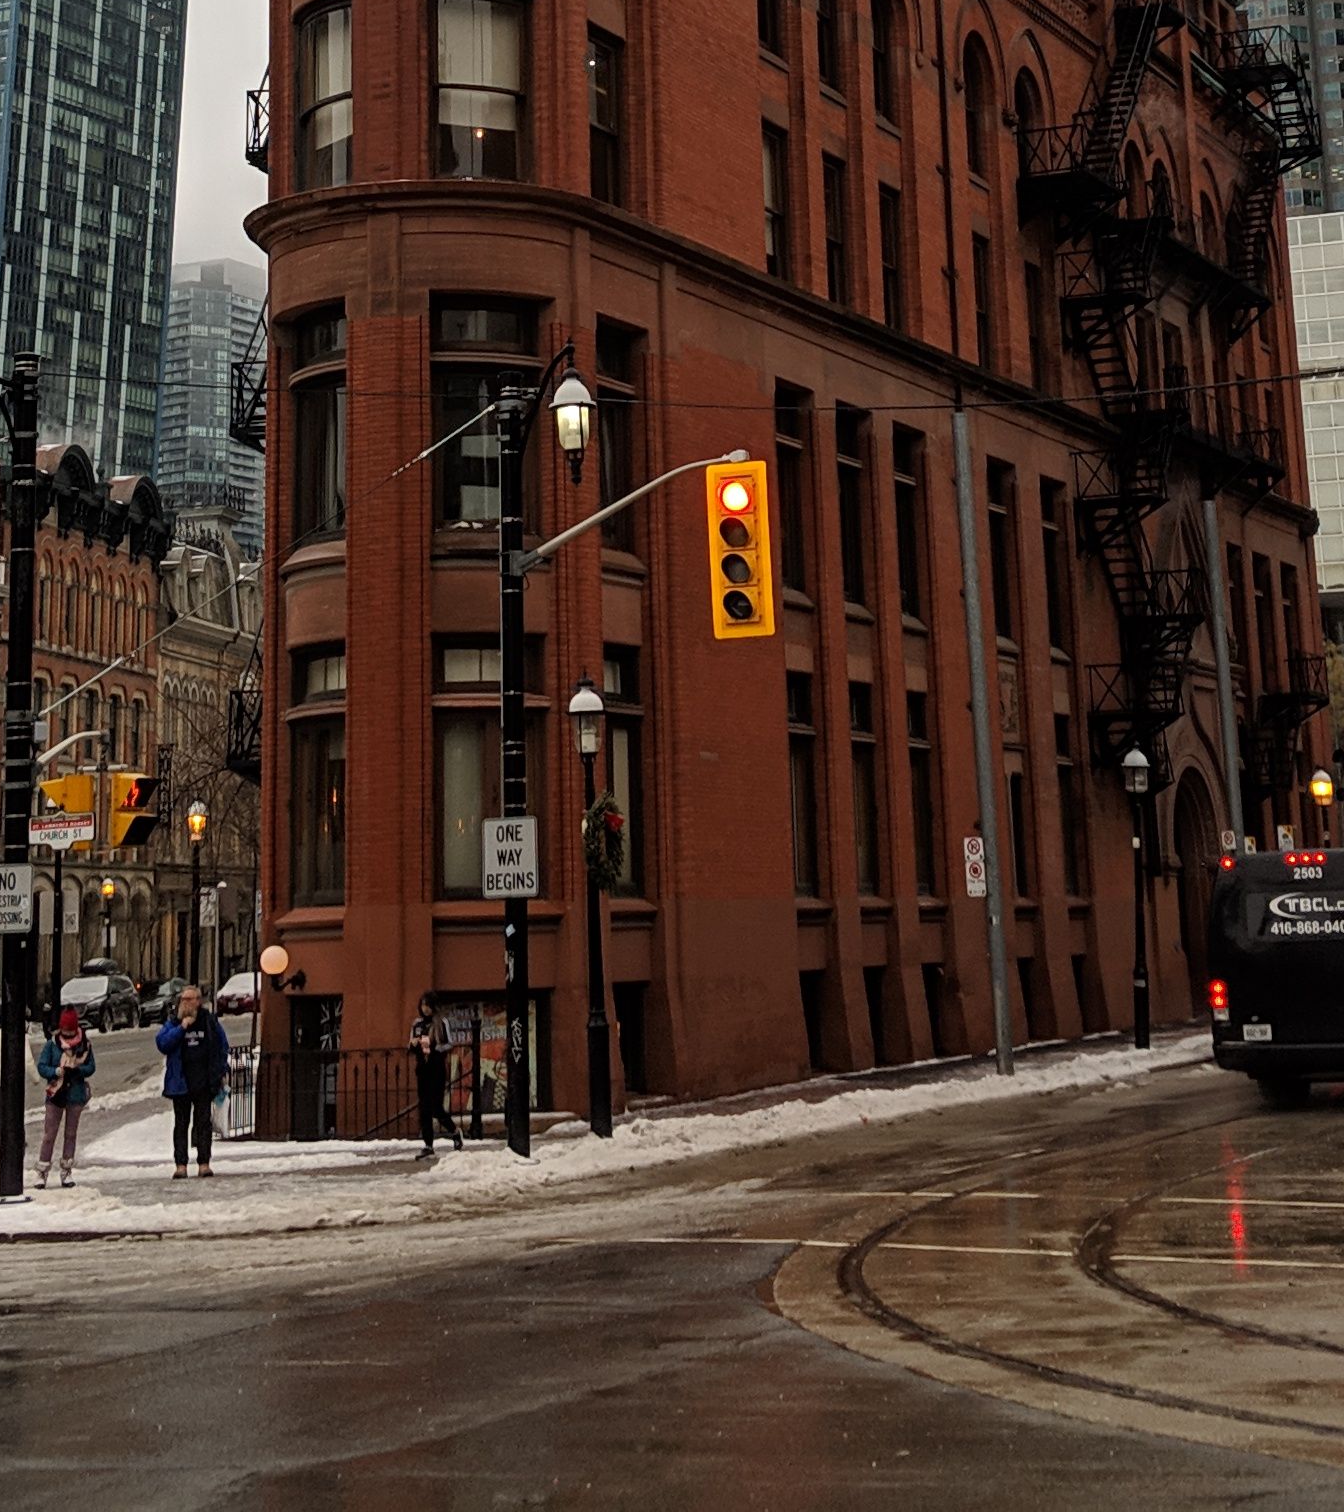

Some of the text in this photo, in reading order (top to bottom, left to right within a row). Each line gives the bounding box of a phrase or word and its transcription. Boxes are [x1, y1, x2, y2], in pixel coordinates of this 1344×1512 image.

[39, 828, 82, 841] CHURCH ST
[496, 824, 523, 842] ONE
[497, 848, 523, 866] WAY
[486, 871, 535, 890] BEGINS
[1293, 866, 1323, 879] 2503
